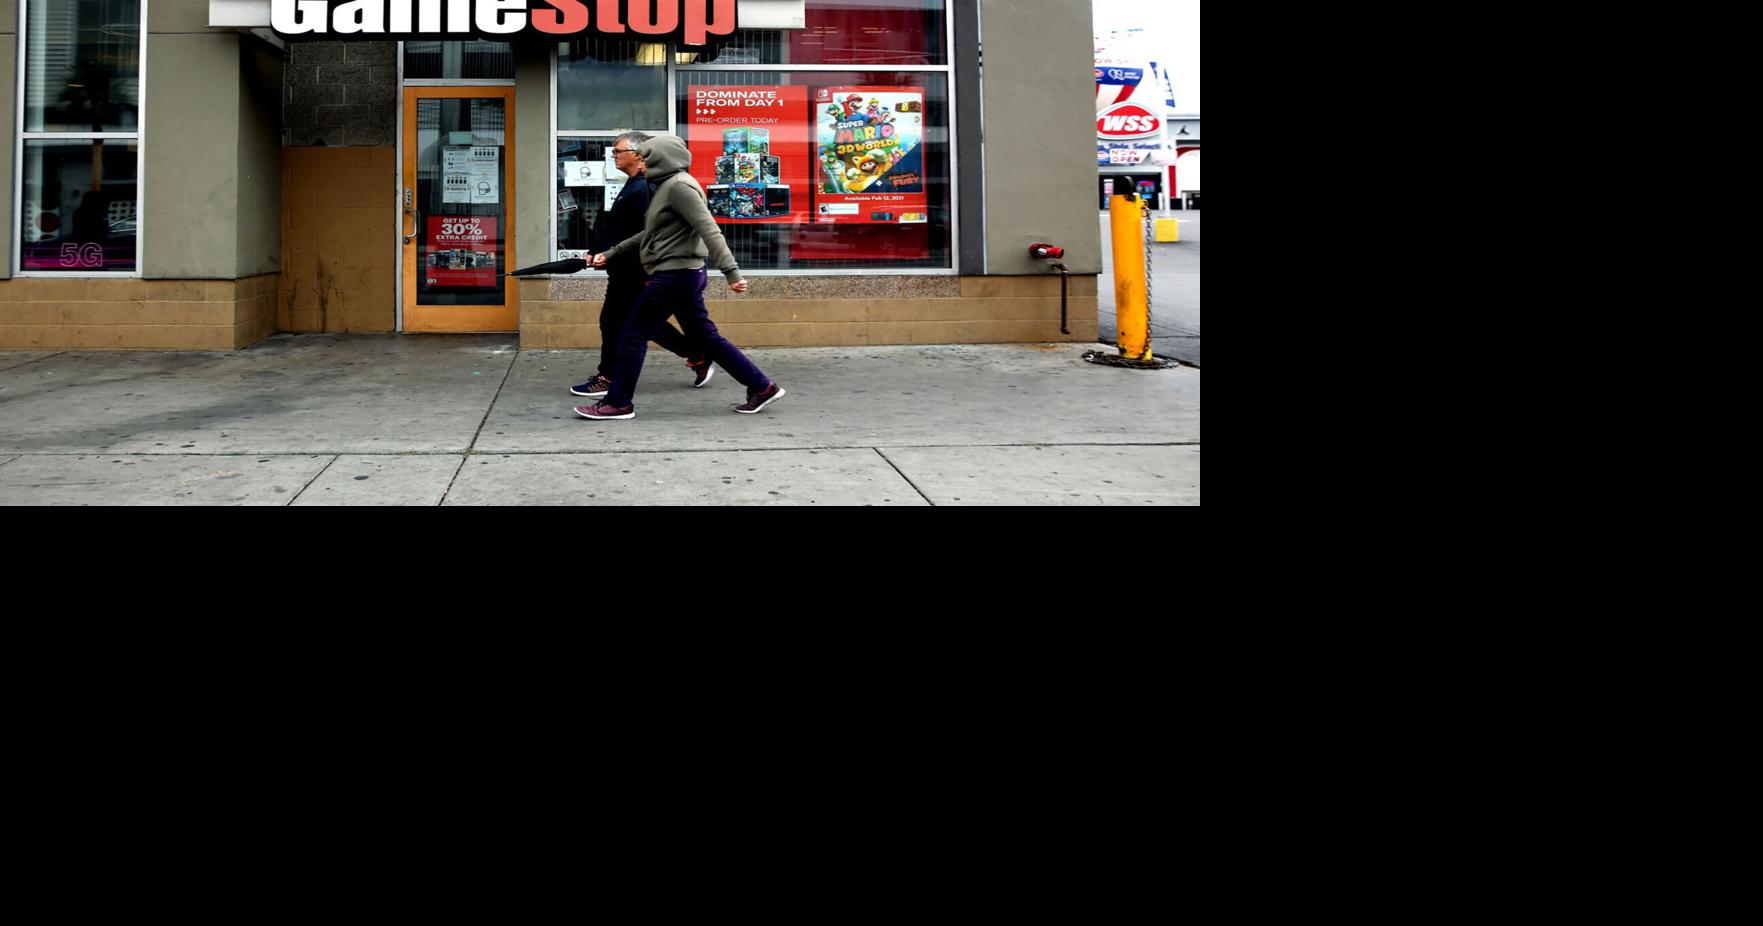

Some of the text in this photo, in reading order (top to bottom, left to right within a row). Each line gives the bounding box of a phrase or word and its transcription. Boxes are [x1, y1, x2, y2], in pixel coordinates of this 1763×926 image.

[837, 120, 864, 129] SUPER
[1103, 115, 1155, 131] WSS
[837, 124, 895, 143] MARIO
[837, 139, 893, 155] 3D WORLD
[441, 223, 482, 235] 30%
[60, 242, 103, 268] 5G
